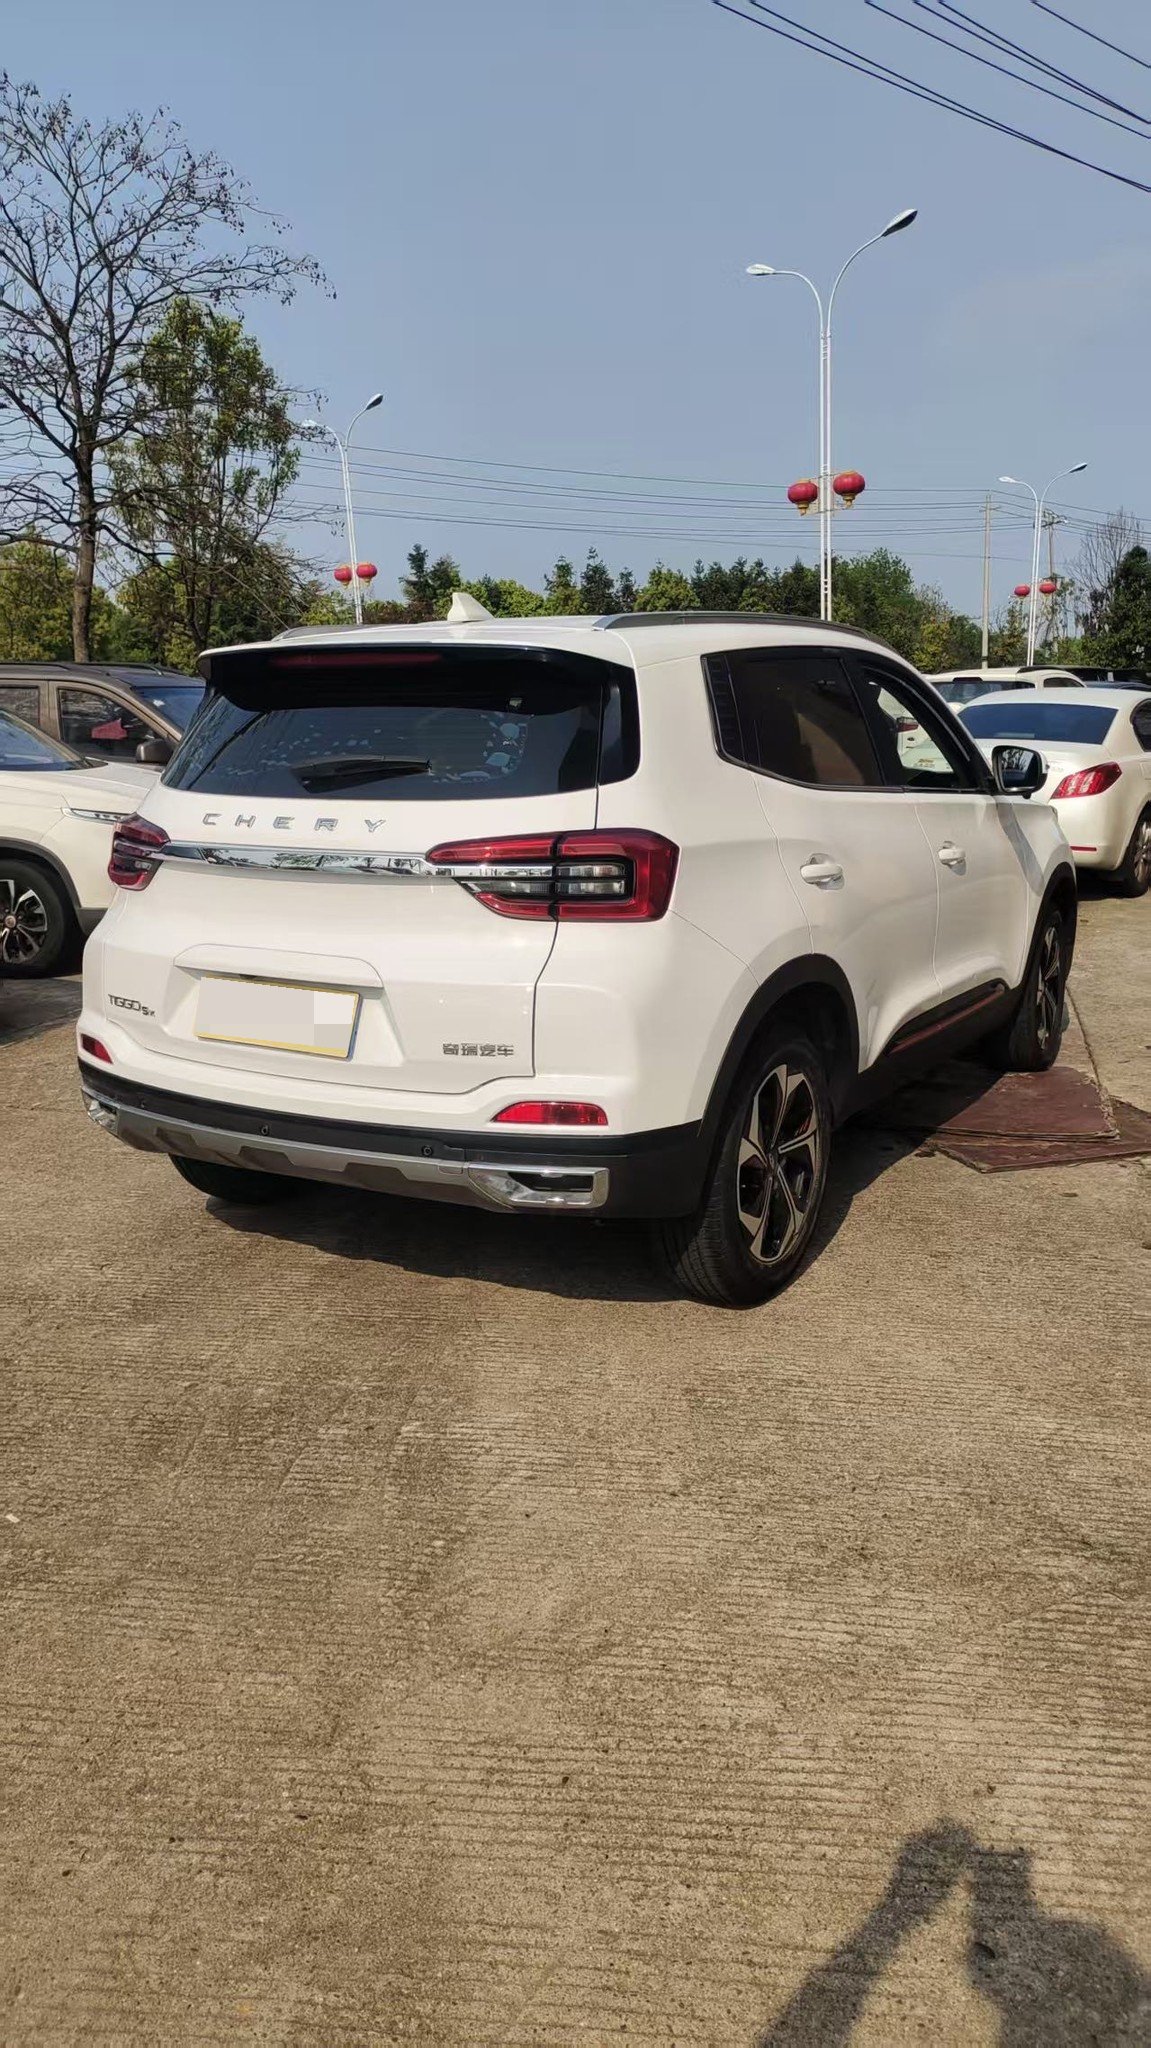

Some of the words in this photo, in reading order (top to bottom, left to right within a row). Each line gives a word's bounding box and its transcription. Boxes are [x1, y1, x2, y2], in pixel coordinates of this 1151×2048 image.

[202, 812, 387, 833] CHERY
[107, 993, 142, 1012] TIGGO
[442, 1042, 515, 1058] 奇瑞汽车
